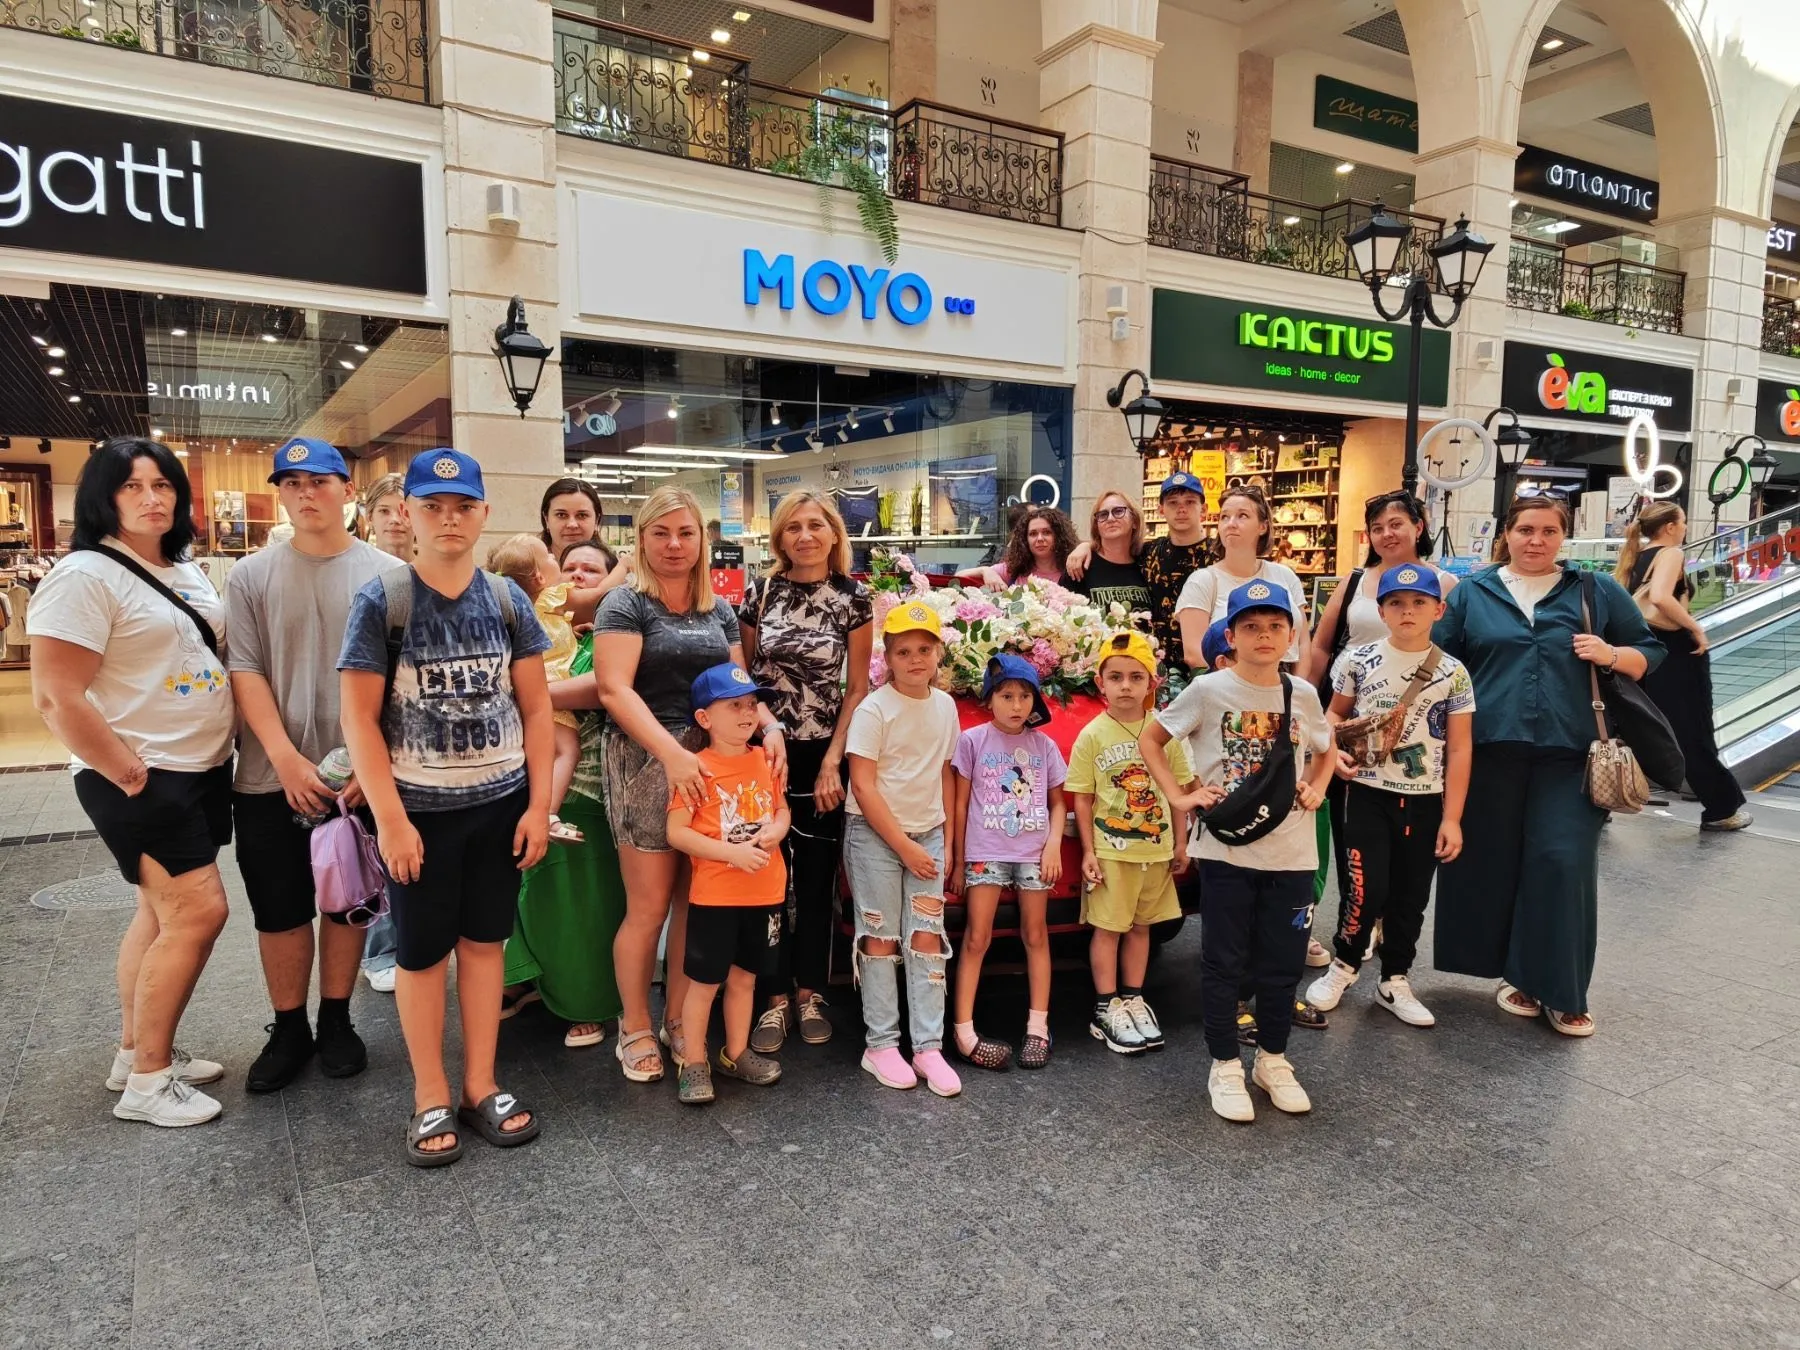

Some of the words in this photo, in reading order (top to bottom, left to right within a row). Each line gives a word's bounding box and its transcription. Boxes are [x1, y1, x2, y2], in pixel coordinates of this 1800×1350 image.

[744, 249, 932, 325] MOYO
[1265, 361, 1292, 377] ideas
[1299, 366, 1327, 381] home
[1334, 371, 1361, 384] decor
[403, 619, 446, 648] EW
[420, 656, 501, 694] CITY
[1365, 654, 1383, 669] 72
[1362, 678, 1389, 697] COAST
[435, 717, 501, 752] 1989
[1399, 724, 1416, 744] TRACK
[1417, 698, 1432, 717] FIELD
[1382, 780, 1432, 791] BROCKLIN
[1235, 805, 1270, 836] PULP
[1292, 903, 1314, 930] 45
[495, 1093, 515, 1105] NIKE
[423, 1108, 449, 1123] NIKE
